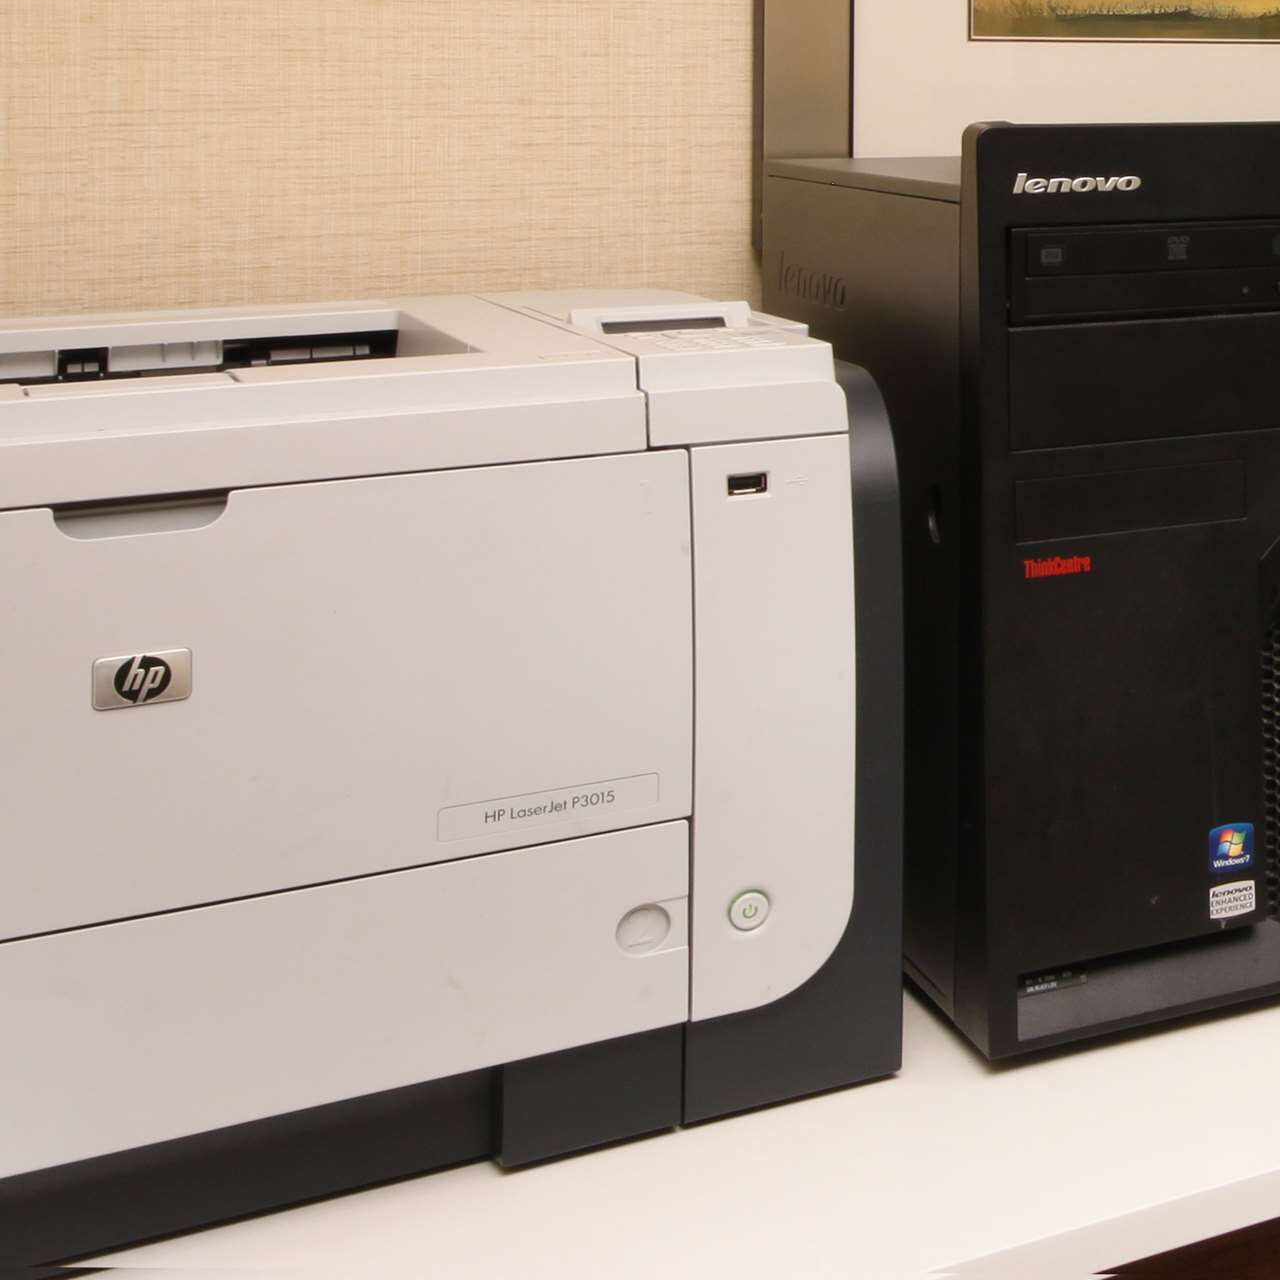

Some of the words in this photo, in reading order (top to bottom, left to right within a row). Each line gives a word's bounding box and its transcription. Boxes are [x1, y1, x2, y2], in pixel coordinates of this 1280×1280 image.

[1012, 172, 1142, 194] lenovo
[778, 250, 848, 311] lenovo
[1024, 556, 1091, 579] ThinkCentre
[122, 655, 165, 704] hp
[484, 808, 506, 824] HP
[510, 800, 567, 820] LaserJet
[572, 790, 616, 810] P3015
[1213, 857, 1244, 868] Windows
[1211, 885, 1253, 898] lenovo
[1211, 892, 1254, 907] ENHANCED
[1211, 901, 1253, 916] EXPERIENCE
